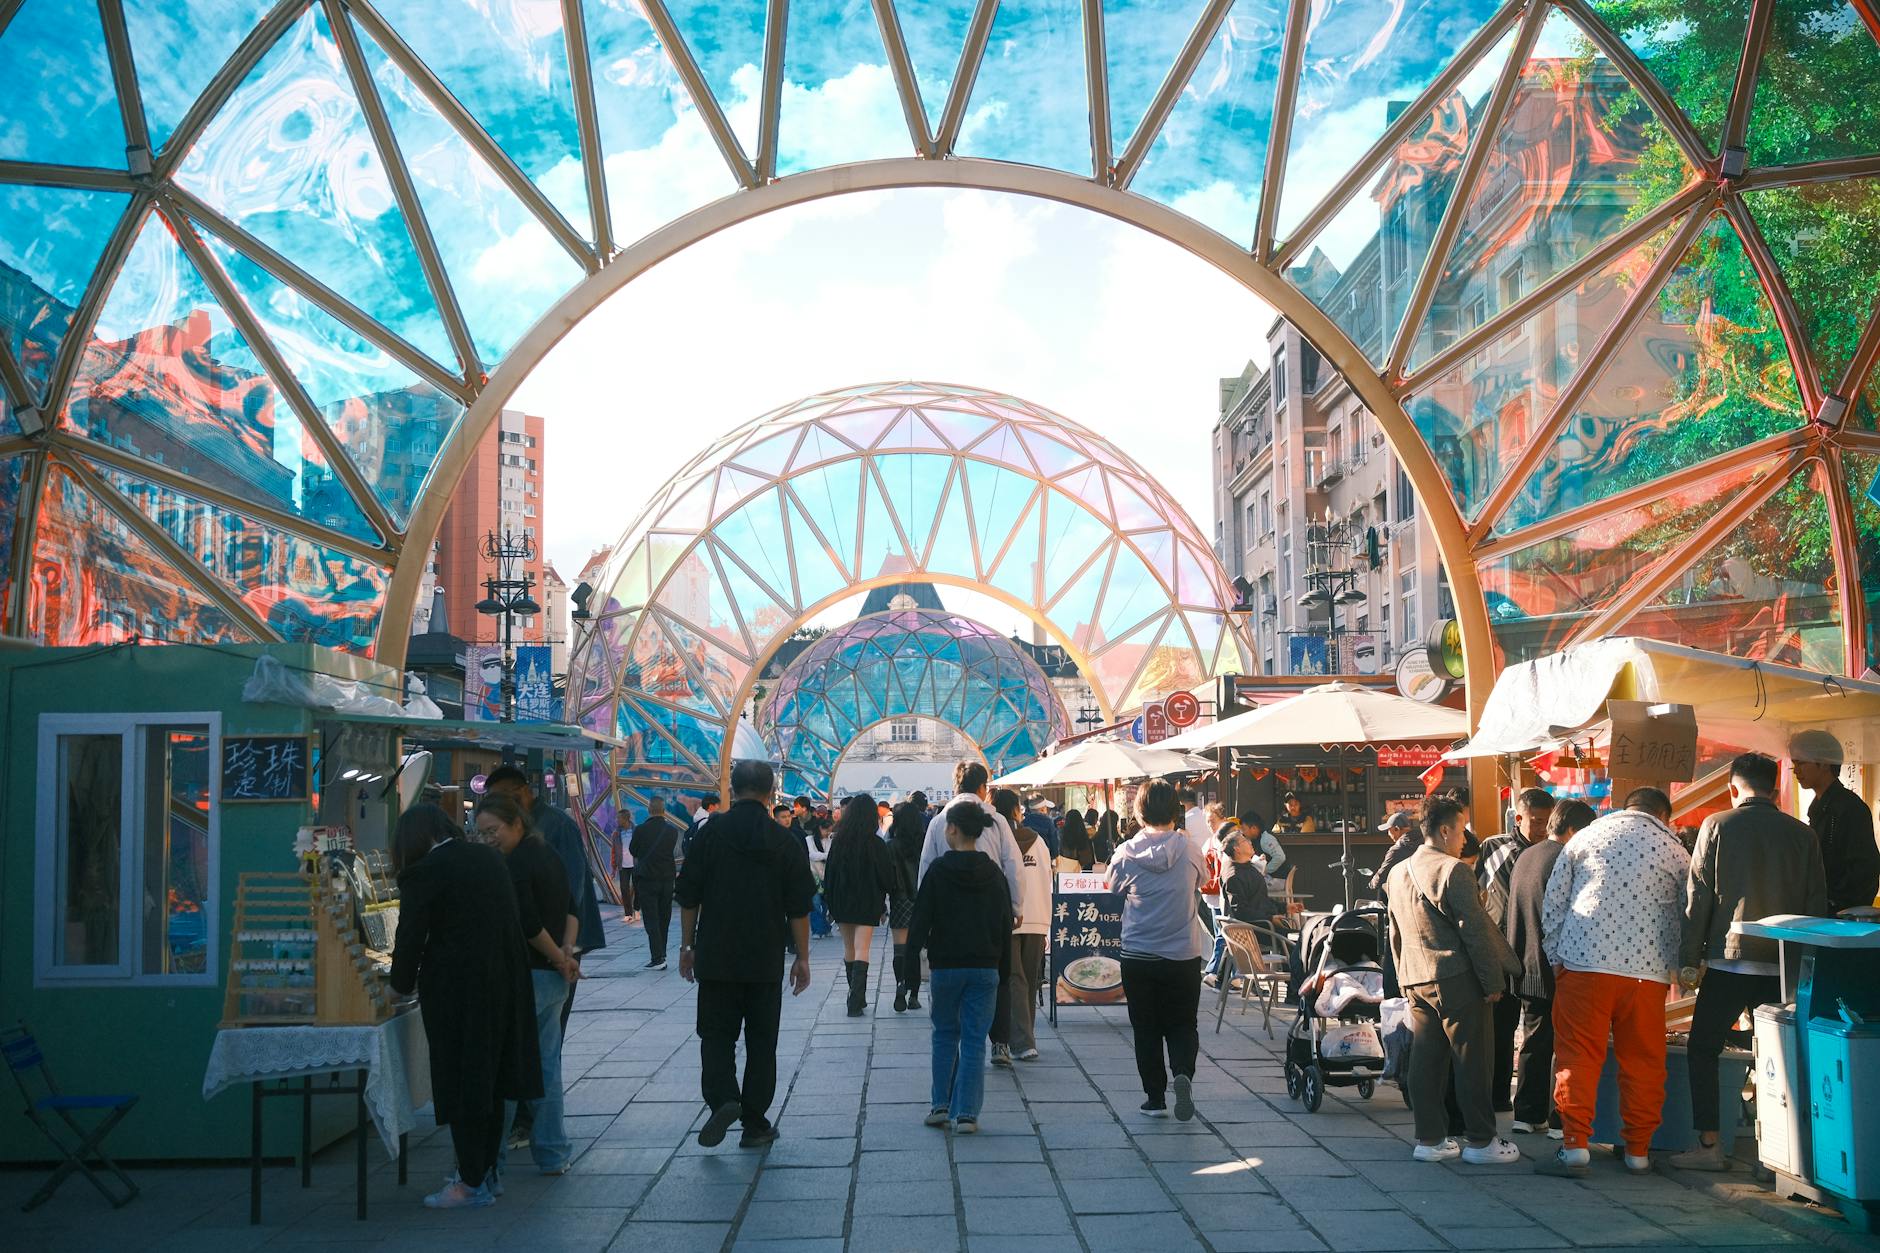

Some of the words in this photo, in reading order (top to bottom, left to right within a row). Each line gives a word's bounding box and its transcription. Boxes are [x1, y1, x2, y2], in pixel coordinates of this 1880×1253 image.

[518, 683, 551, 698] 大连
[225, 740, 304, 775] 珍珠
[1064, 879, 1097, 889] 石榴汁
